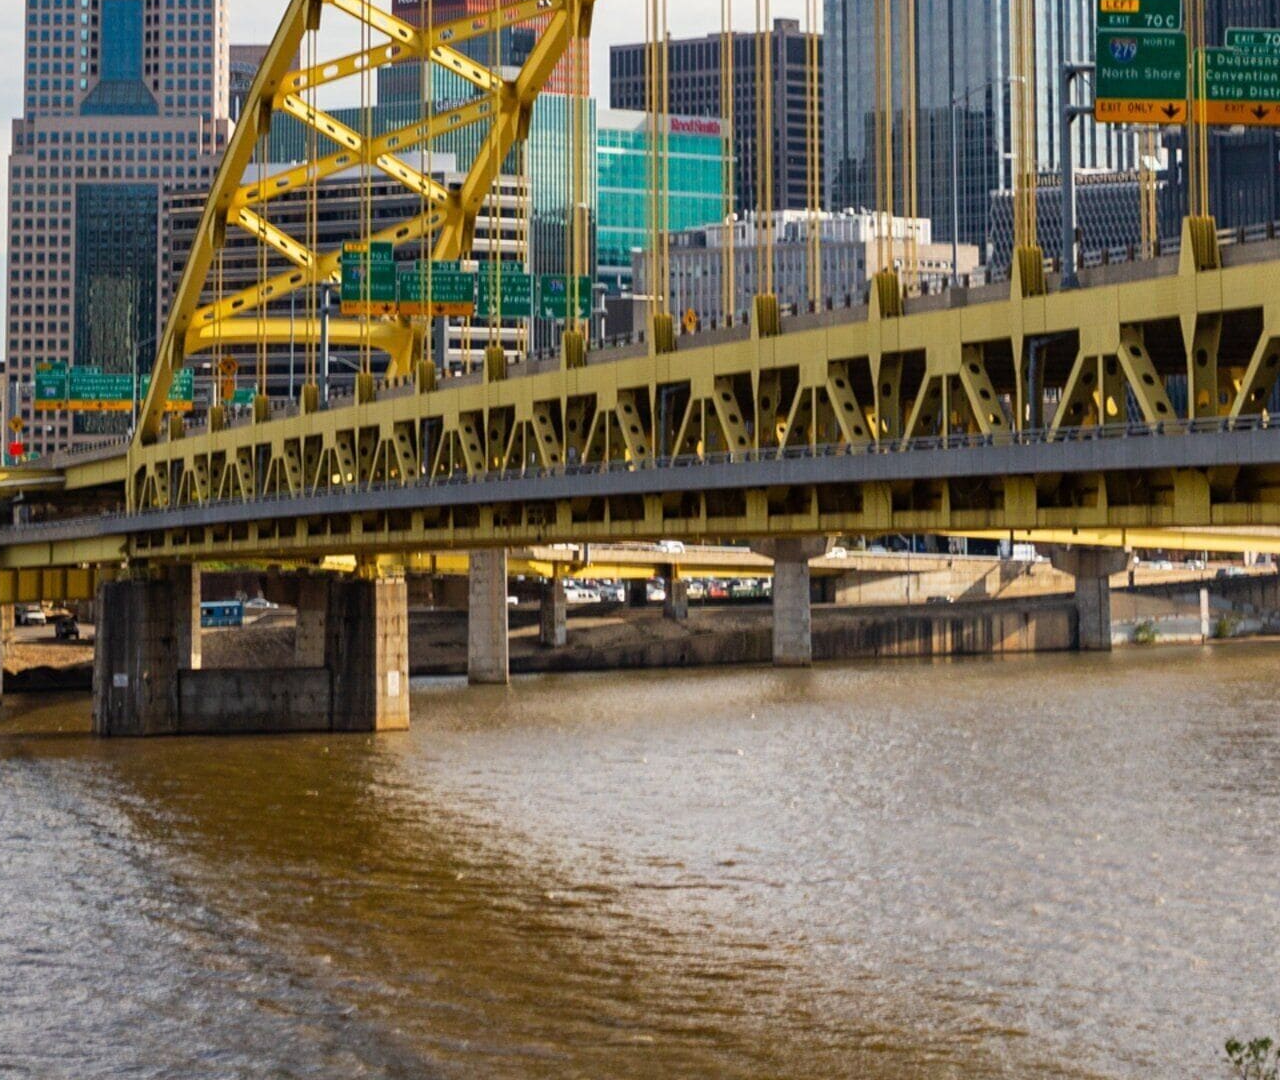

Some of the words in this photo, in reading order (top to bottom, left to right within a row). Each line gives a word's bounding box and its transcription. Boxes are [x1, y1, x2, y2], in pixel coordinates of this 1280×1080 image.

[1106, 0, 1133, 9] LEFT
[1109, 15, 1130, 24] EXIT
[1143, 37, 1176, 46] NORTH
[1234, 34, 1255, 44] EXIT
[1113, 42, 1137, 59] 279
[1217, 54, 1279, 67] Duquesne
[1102, 67, 1138, 79] North
[1144, 67, 1181, 80] Shore
[1206, 69, 1278, 81] Convention
[1211, 85, 1244, 98] Strip
[1101, 103, 1121, 112] EXIT
[1128, 103, 1154, 113] ONLY
[1224, 104, 1245, 113] EXIT
